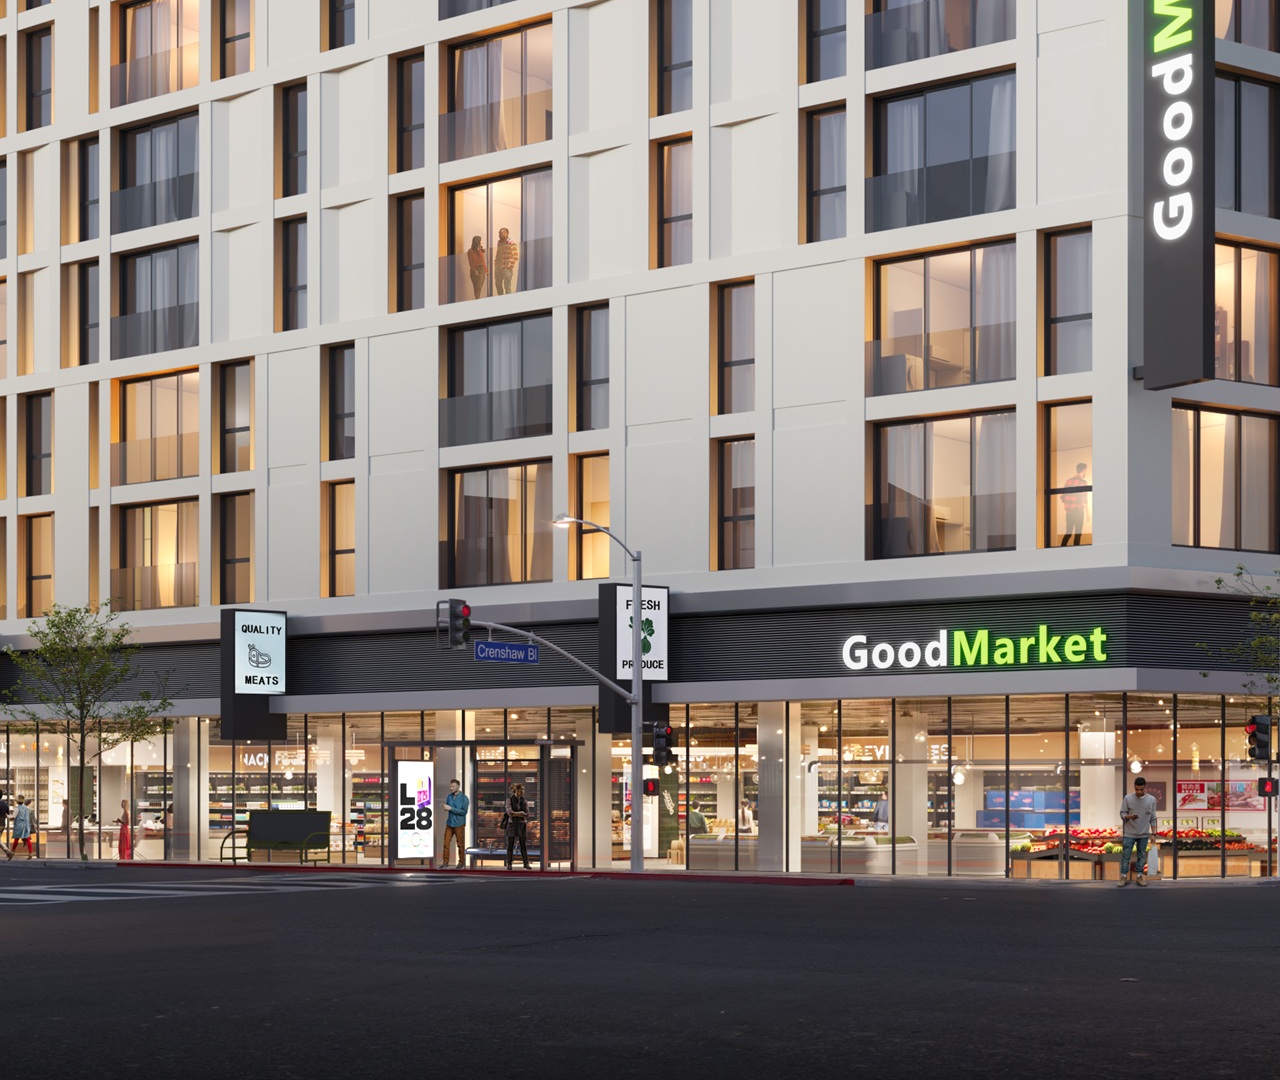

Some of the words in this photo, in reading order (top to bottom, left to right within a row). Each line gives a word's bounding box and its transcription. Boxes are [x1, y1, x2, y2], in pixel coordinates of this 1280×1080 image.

[626, 600, 660, 610] FESH
[241, 624, 282, 635] QUALITY
[477, 644, 525, 660] Crenshaw
[528, 648, 537, 660] Bl
[841, 624, 1108, 671] GoodMarket
[622, 660, 664, 669] PRDUCE
[244, 675, 279, 685] MEATS
[400, 807, 433, 830] 28
